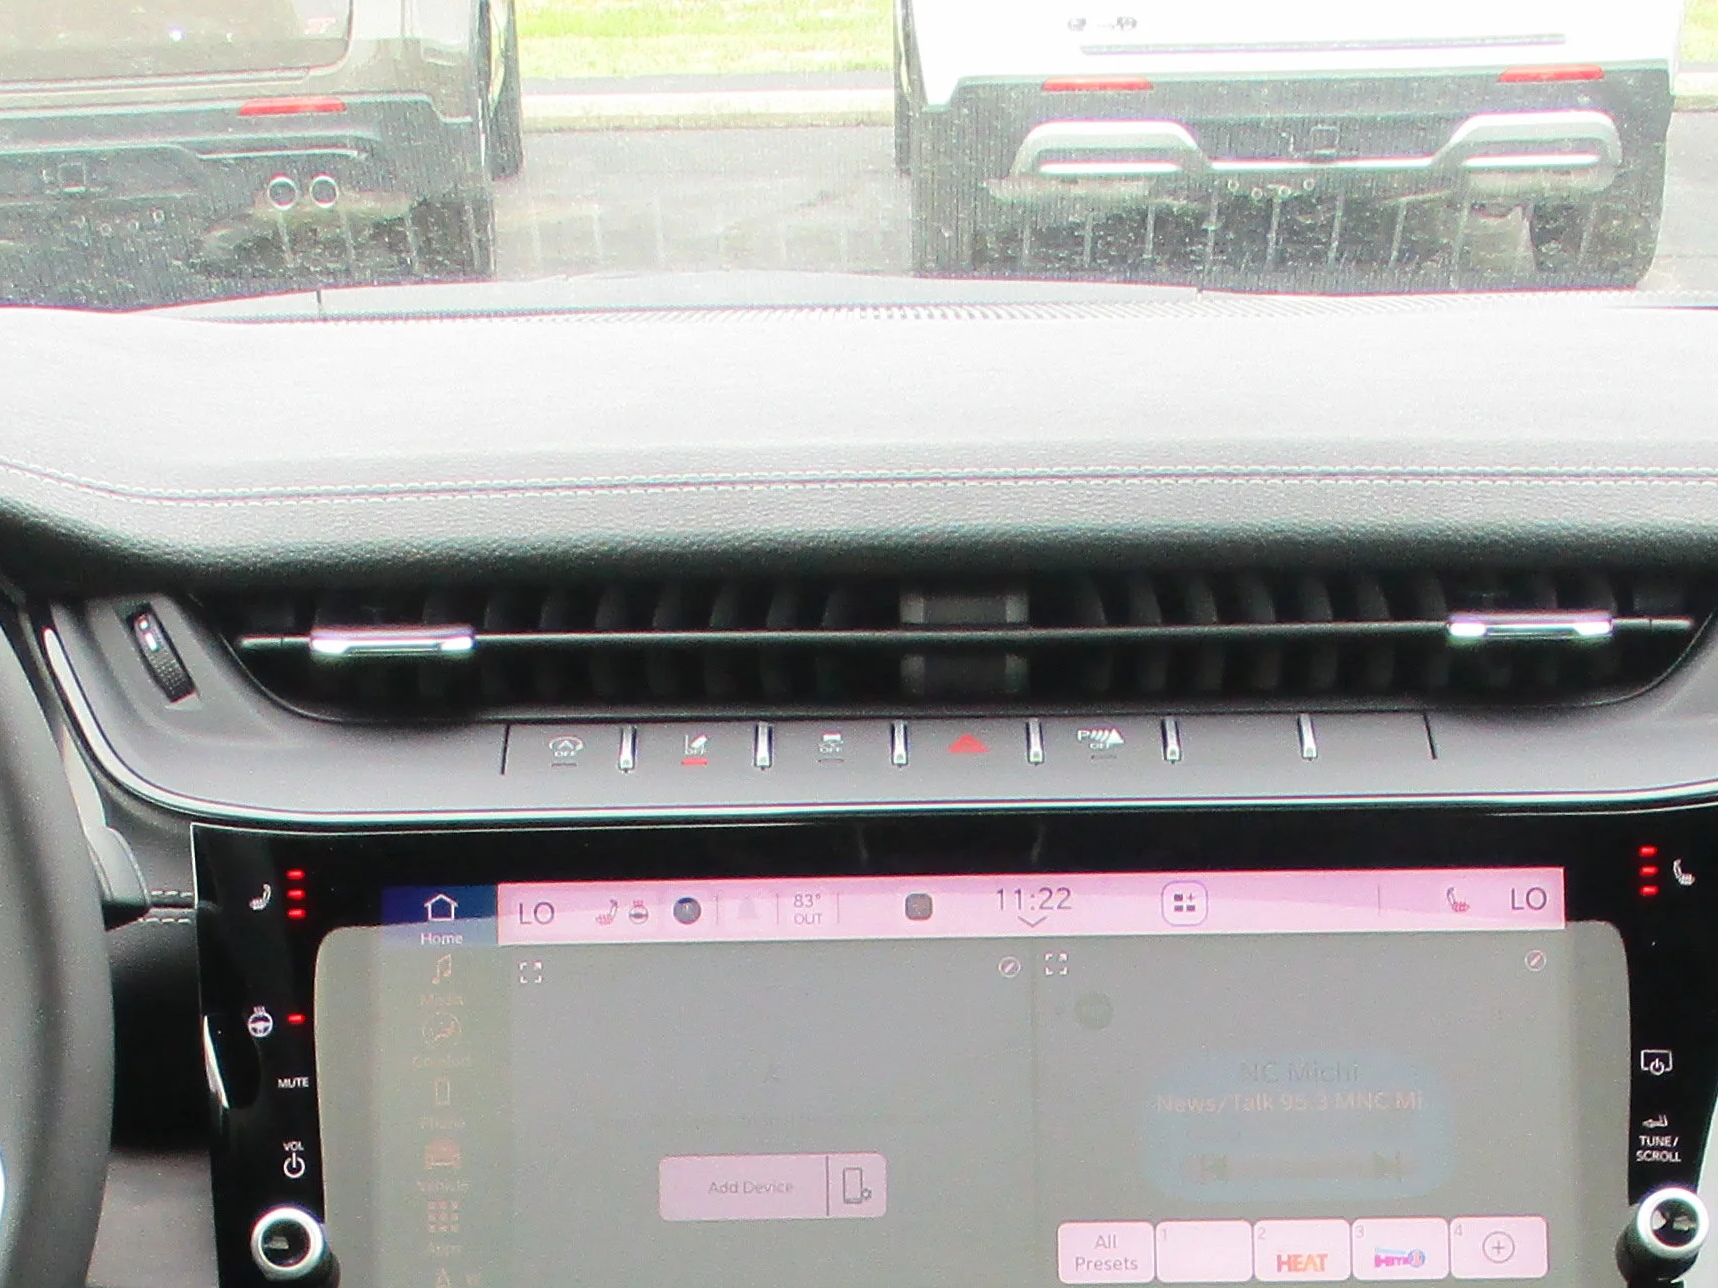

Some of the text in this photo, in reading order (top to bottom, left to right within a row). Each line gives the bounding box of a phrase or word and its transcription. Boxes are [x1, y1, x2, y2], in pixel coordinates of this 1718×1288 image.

[793, 893, 822, 909] 83°
[995, 886, 1073, 911] 11:22
[1511, 887, 1547, 910] LO
[518, 902, 555, 925] LO
[793, 912, 823, 925] OUT
[420, 932, 464, 945] Home
[277, 1077, 310, 1089] MUTE
[1155, 1091, 1273, 1116] News/Talk
[283, 1141, 305, 1152] VOL
[1638, 1135, 1679, 1148] TUNE/
[1635, 1149, 1682, 1163] SCROLL
[707, 1180, 794, 1194] Add Device
[1257, 1227, 1267, 1240] 2
[1355, 1225, 1364, 1238] 3
[1453, 1224, 1463, 1237] 4
[1094, 1234, 1117, 1250] All
[1075, 1256, 1139, 1272] Presets
[1276, 1253, 1329, 1273] HEAT
